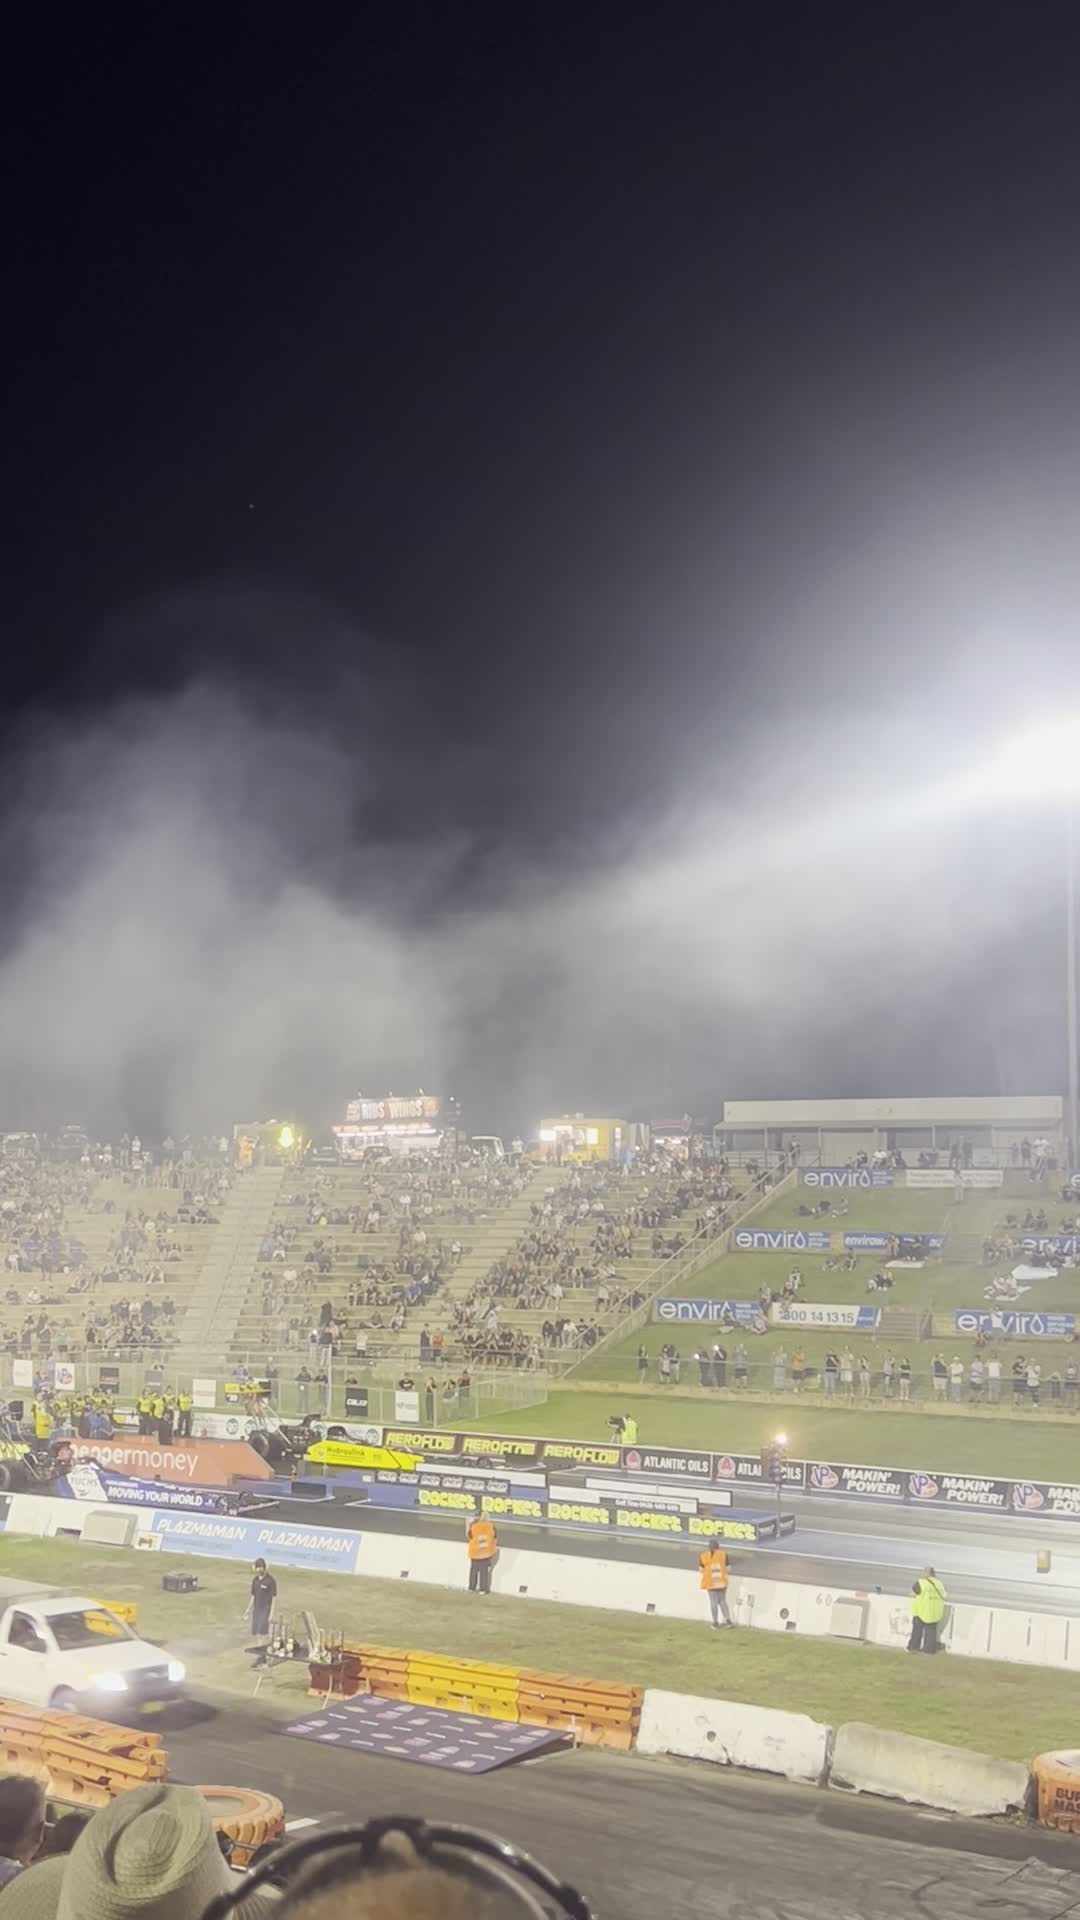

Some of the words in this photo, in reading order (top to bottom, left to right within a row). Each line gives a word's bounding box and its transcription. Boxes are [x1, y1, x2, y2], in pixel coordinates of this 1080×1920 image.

[804, 1168, 871, 1188] enviro
[736, 1231, 806, 1249] enviro
[643, 1455, 686, 1471] ATLANTIC
[687, 1460, 709, 1473] OILS
[108, 1486, 145, 1501] MOVING
[145, 1490, 170, 1503] YOUR
[170, 1493, 203, 1507] WORLD
[847, 1479, 901, 1495] POWER!
[947, 1490, 1004, 1506] POWER!
[157, 1518, 248, 1541] PLAZMAMAN
[257, 1528, 354, 1553] PLAZMAMAN
